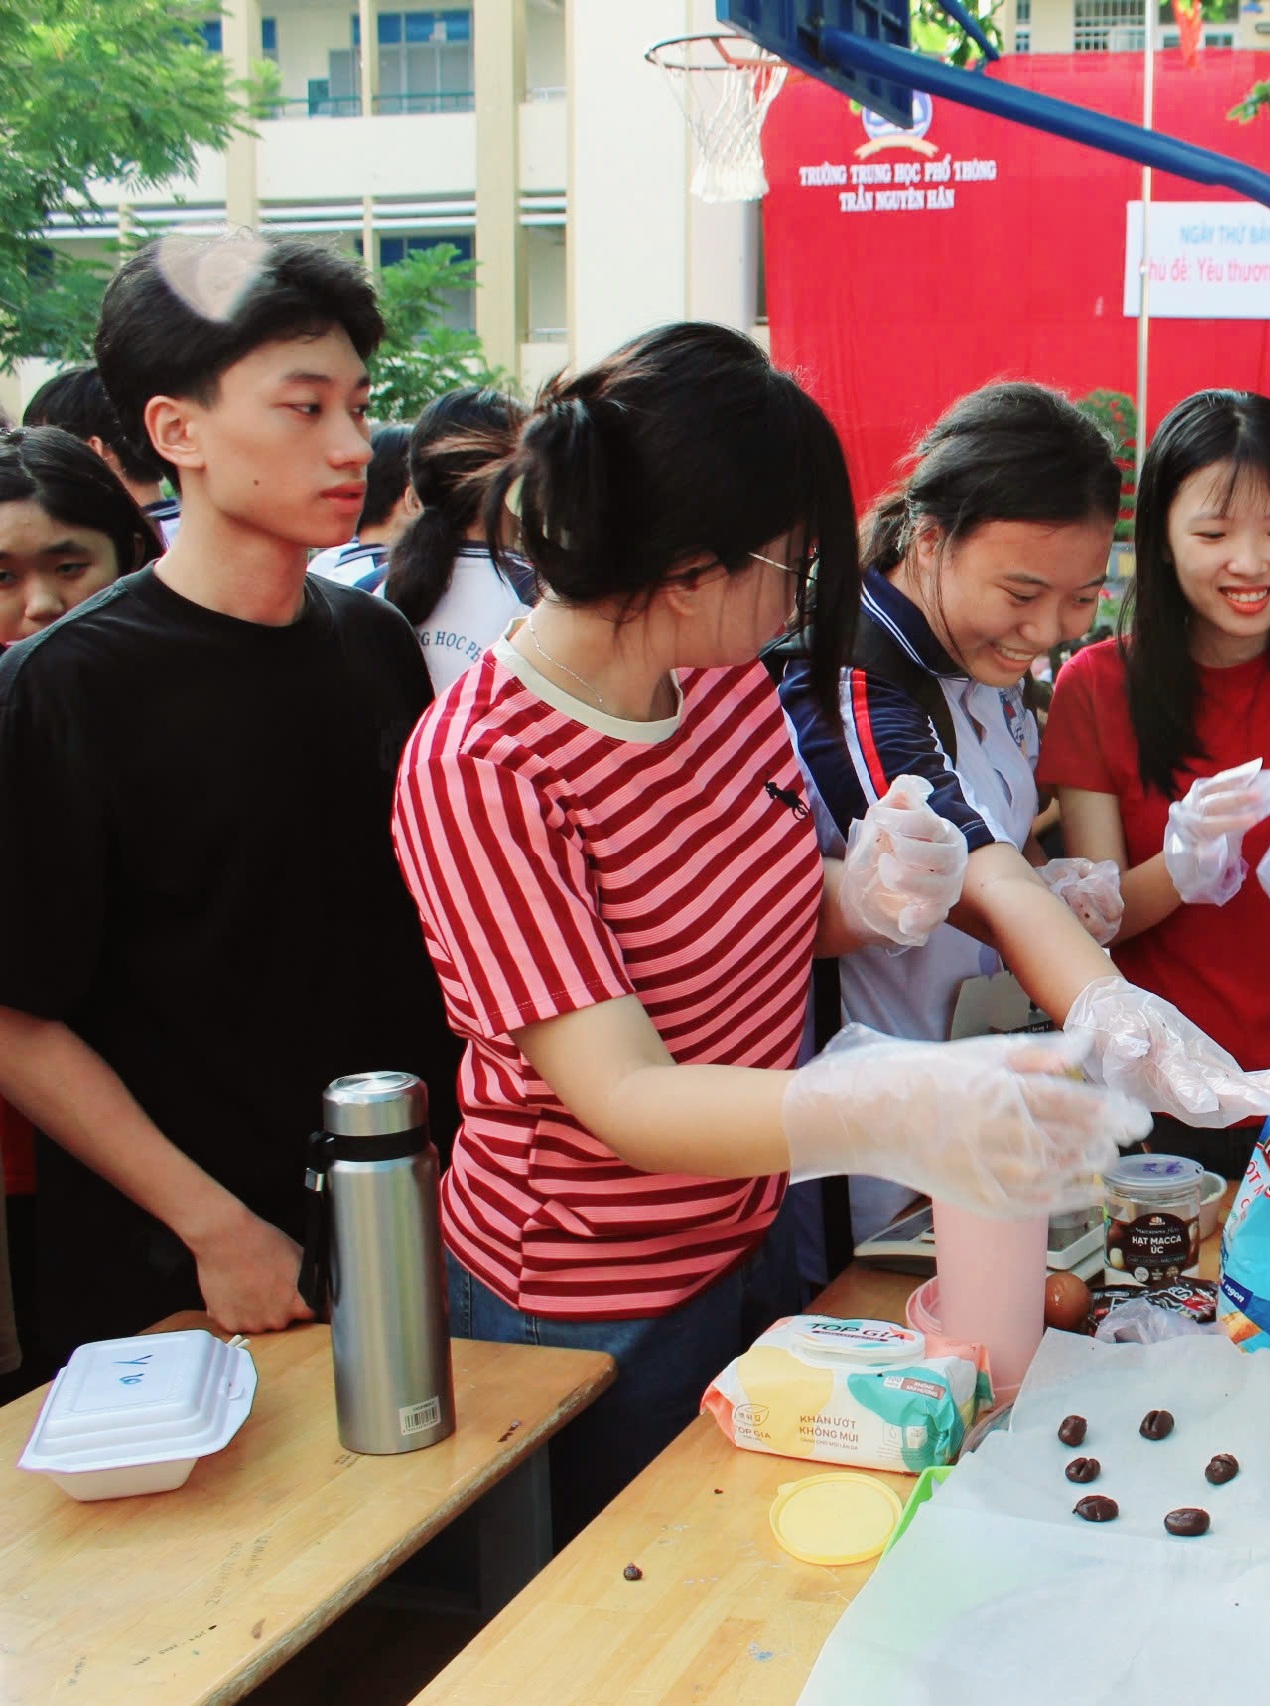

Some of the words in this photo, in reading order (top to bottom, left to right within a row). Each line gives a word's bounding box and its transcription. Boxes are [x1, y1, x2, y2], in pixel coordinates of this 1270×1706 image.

[851, 164, 892, 184] TRUNG
[894, 163, 921, 186] HỌC
[1132, 1236, 1148, 1247] HẠT
[1150, 1235, 1181, 1245] MACCA
[810, 1323, 860, 1332] TOP
[862, 1329, 905, 1341] GIA
[753, 1430, 771, 1440] GIA
[799, 1426, 838, 1439] KHÔNG
